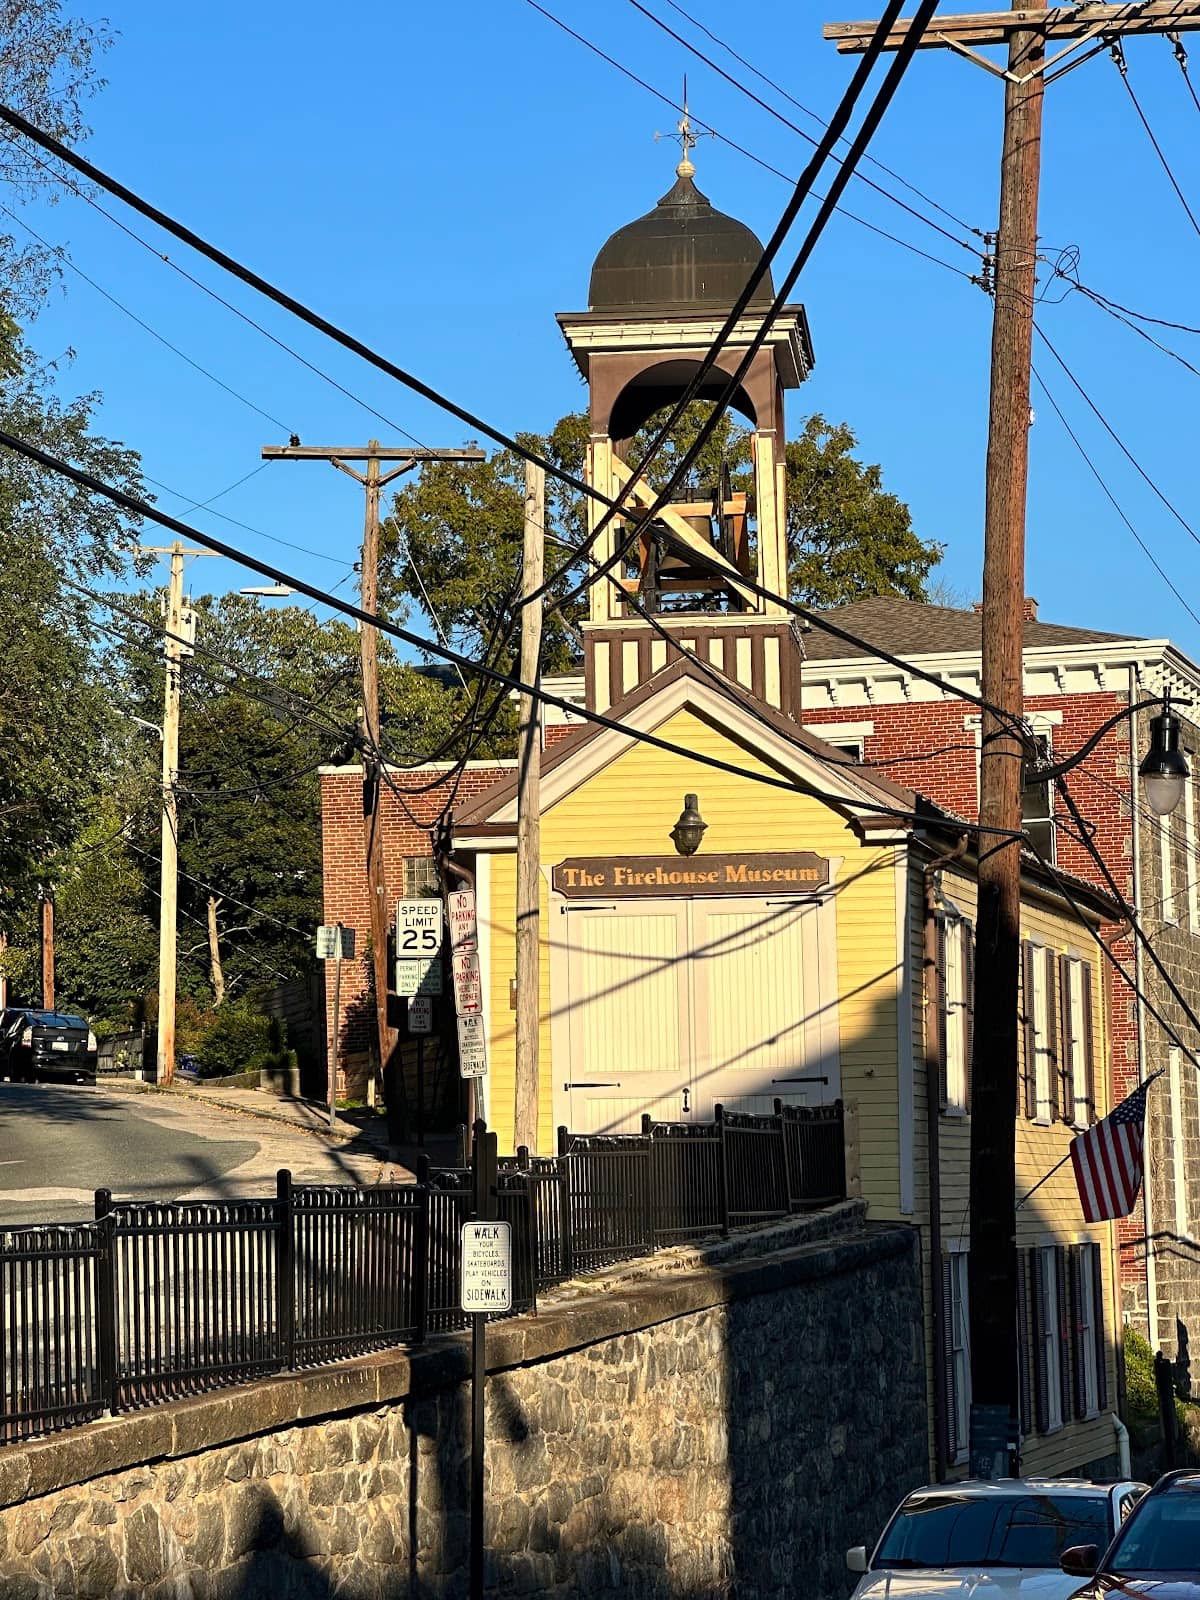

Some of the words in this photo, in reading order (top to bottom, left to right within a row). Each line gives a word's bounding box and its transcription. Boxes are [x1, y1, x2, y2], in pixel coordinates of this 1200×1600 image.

[563, 868, 604, 887] The
[614, 865, 719, 886] Firehouse
[725, 863, 820, 883] Museum
[457, 895, 467, 908] NO
[401, 906, 438, 915] SPEED
[451, 910, 475, 921] PARKING
[405, 918, 434, 926] LIMIT
[402, 929, 437, 949] 25
[461, 957, 470, 969] NO
[456, 970, 478, 982] PARKING
[474, 1227, 499, 1239] WALK
[466, 1288, 506, 1300] SIDEWALK
